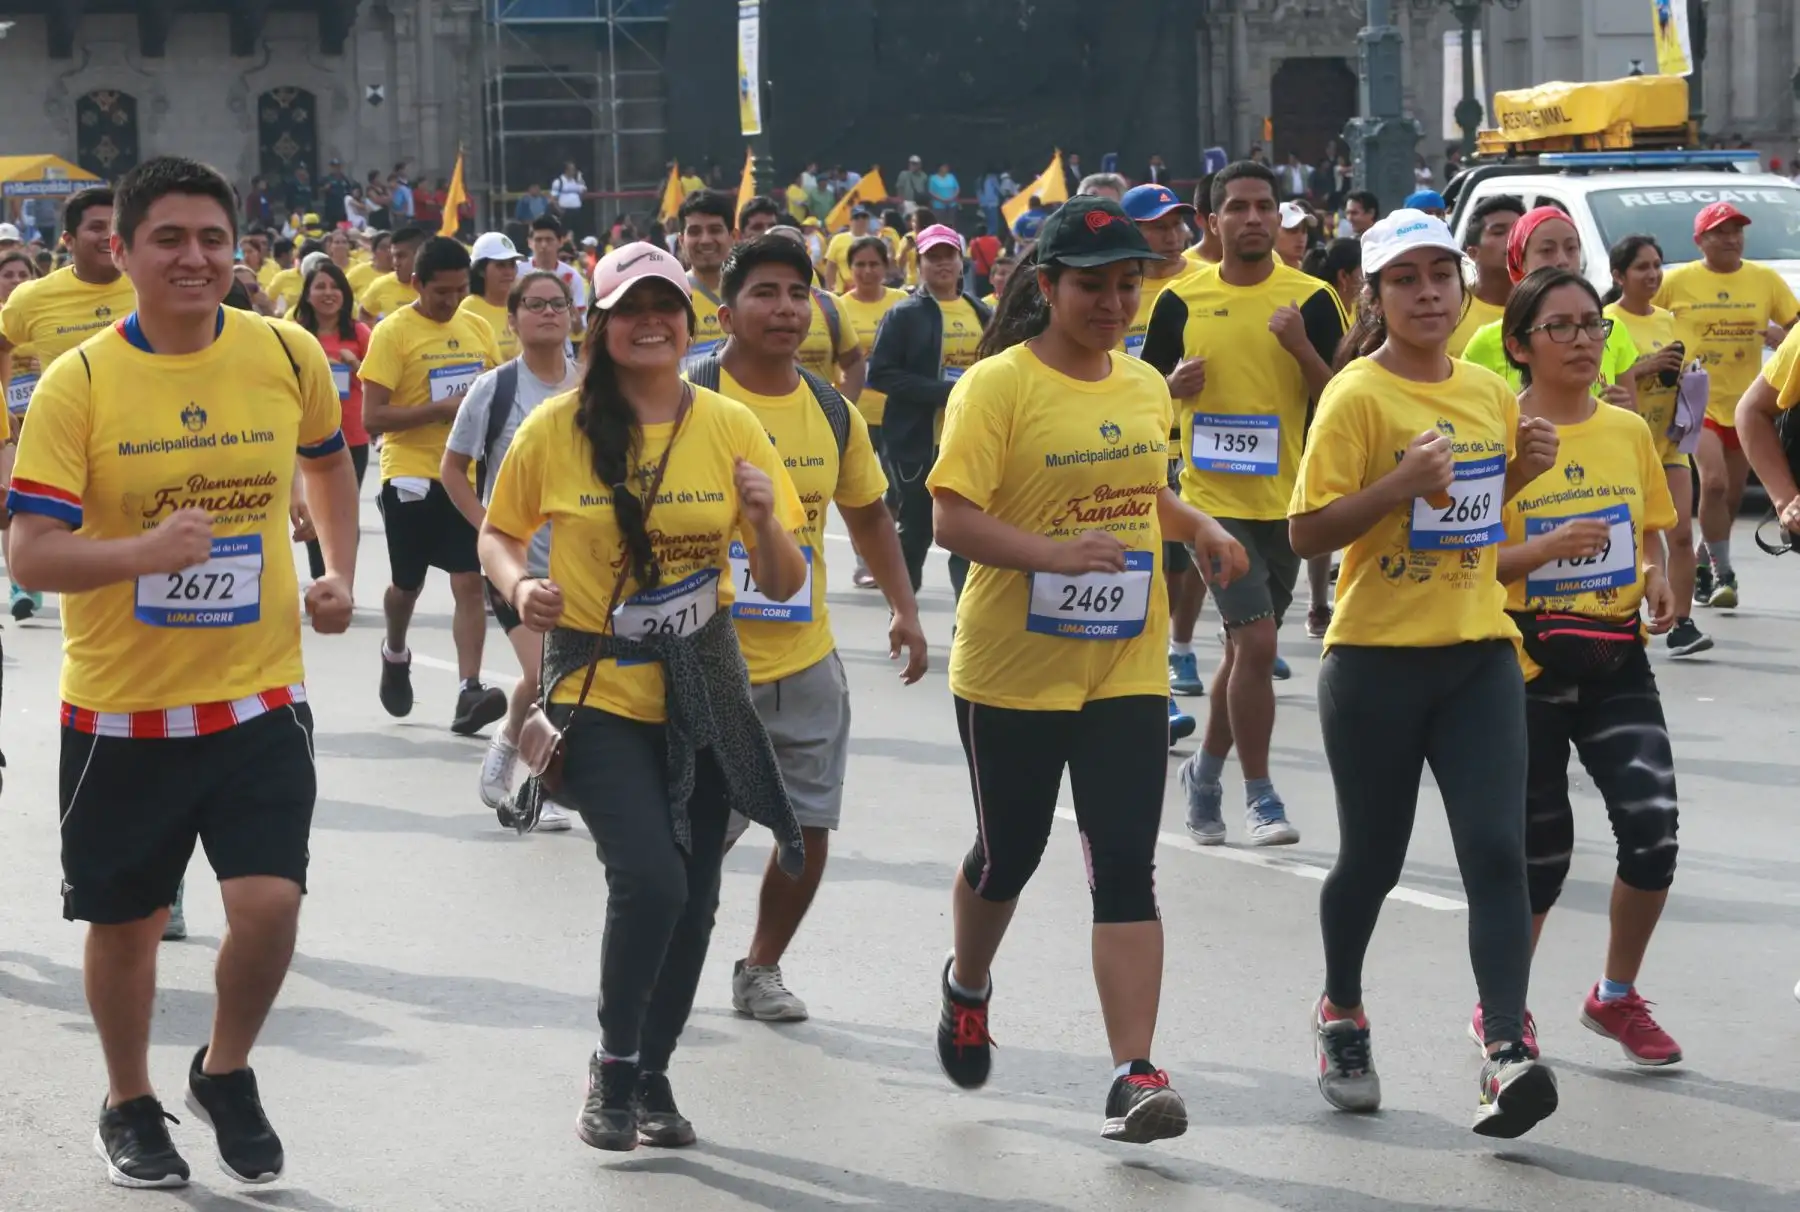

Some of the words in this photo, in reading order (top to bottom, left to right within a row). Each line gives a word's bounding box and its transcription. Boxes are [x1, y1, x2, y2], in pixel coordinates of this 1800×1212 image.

[1618, 190, 1787, 208] RESCATE
[118, 433, 216, 456] Municipalidad
[220, 433, 238, 445] de
[241, 430, 275, 443] Lima
[1214, 433, 1258, 453] 1359
[1470, 442, 1484, 453] de
[784, 456, 797, 467] de
[799, 456, 824, 467] Lima
[1045, 444, 1129, 467] Municipalidad
[1132, 443, 1148, 455] de
[1211, 461, 1257, 472] LIMACORRE
[186, 471, 278, 494] Bienvenido
[677, 492, 693, 503] de
[695, 490, 724, 503] Lima
[1516, 486, 1594, 513] Municipalidad
[1596, 486, 1611, 497] de
[1612, 485, 1637, 497] Lima
[1440, 492, 1491, 523] 2669
[1105, 522, 1127, 532] CON
[1439, 530, 1489, 544] LIMACORRE
[222, 544, 231, 552] de
[232, 543, 249, 551] Lima
[166, 572, 236, 601] 2672
[1555, 575, 1613, 592] LIMACORRE
[1058, 584, 1125, 613] 2469
[166, 611, 235, 623] LIMACORRE
[642, 602, 698, 637] 2671
[738, 607, 792, 618] LIMACORRE
[1057, 623, 1119, 636] LIMACORRE
